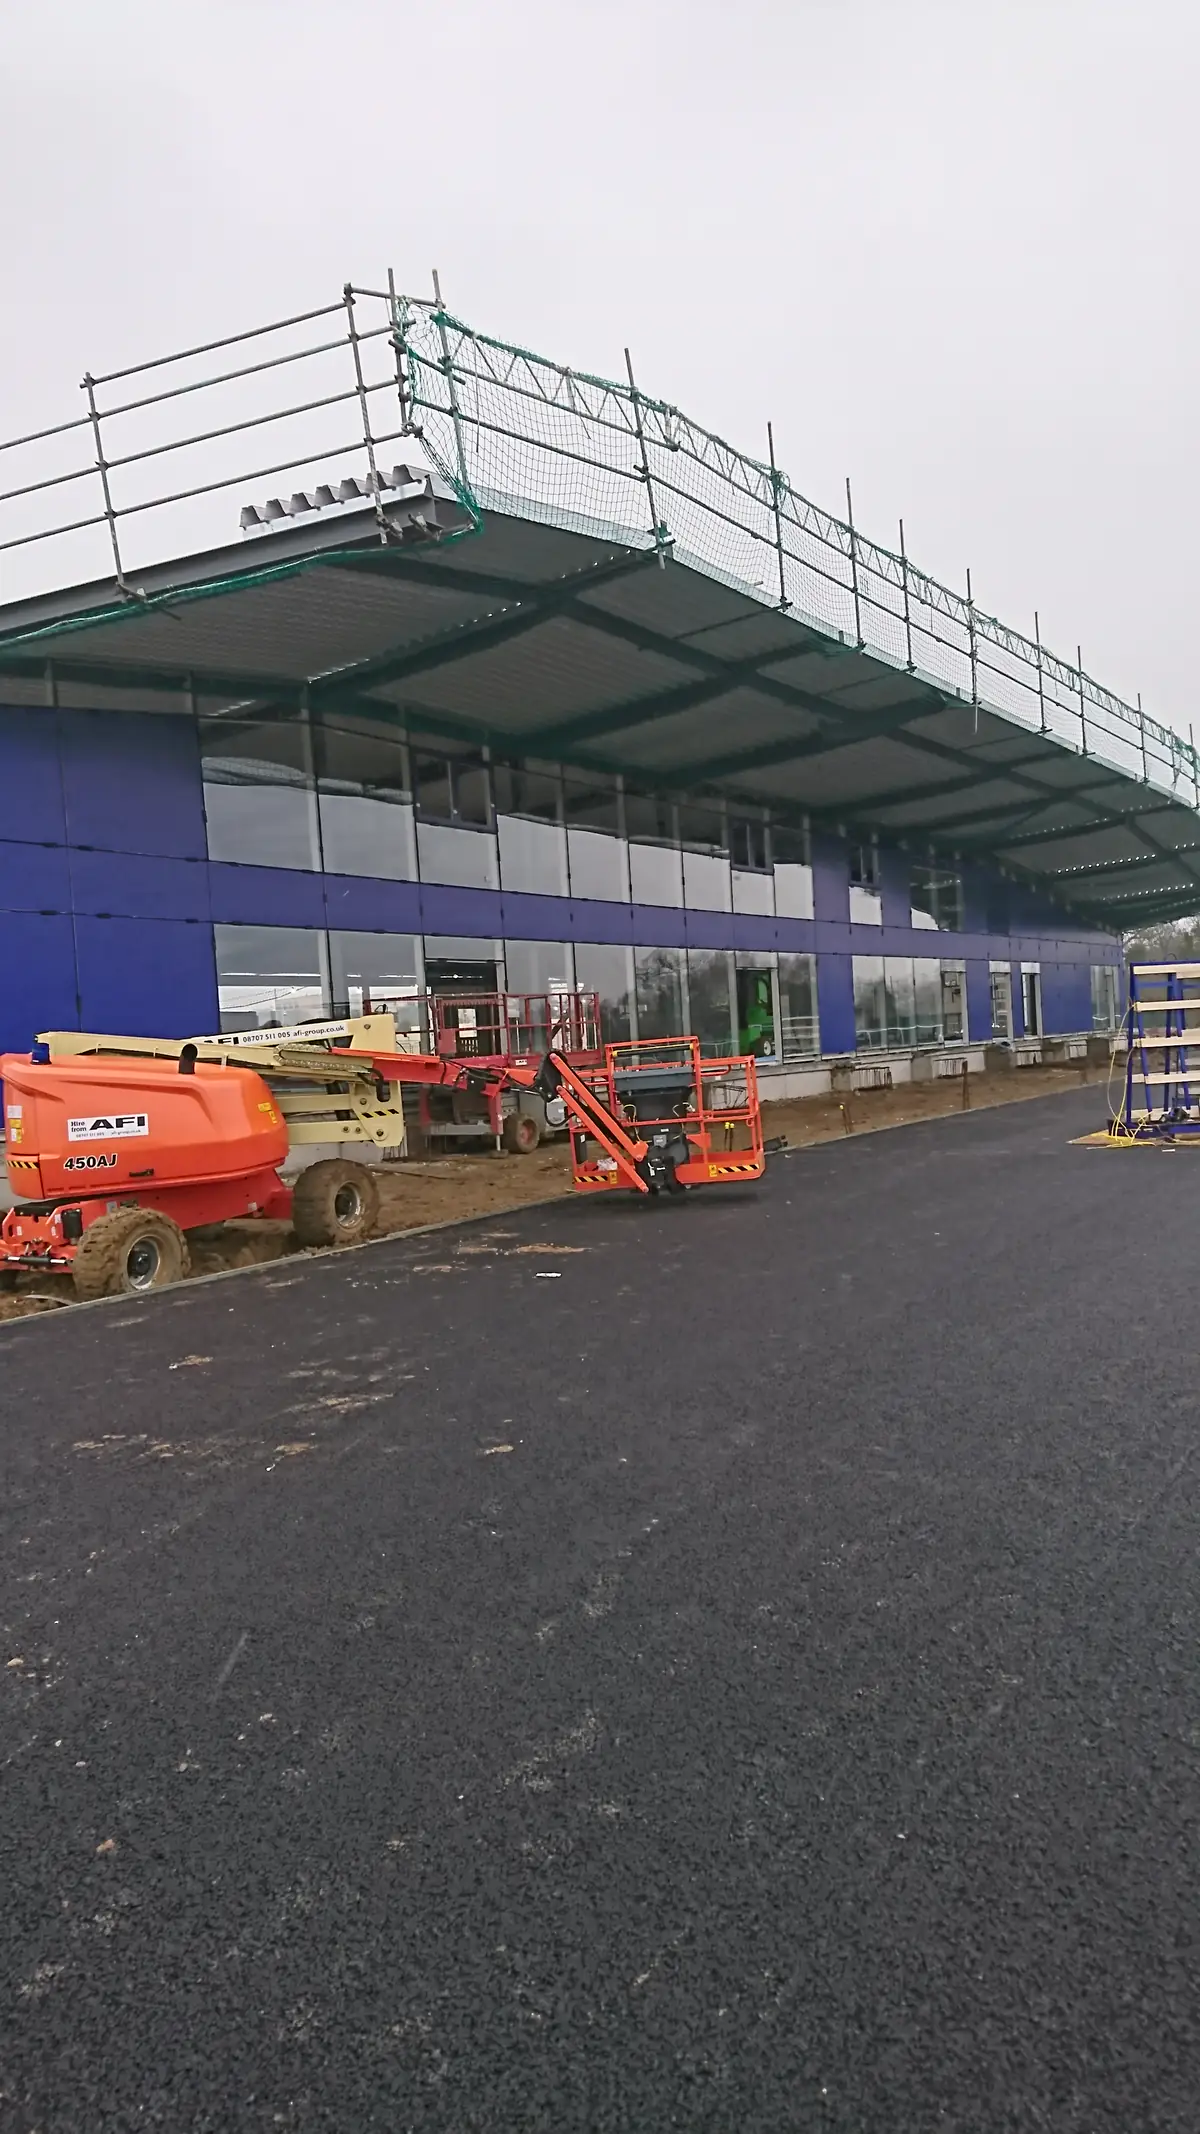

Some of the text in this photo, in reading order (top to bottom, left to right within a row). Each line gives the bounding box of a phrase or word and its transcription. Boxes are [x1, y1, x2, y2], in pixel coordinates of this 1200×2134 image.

[243, 1034, 264, 1043] 08707
[277, 1031, 291, 1039] 005
[293, 1025, 345, 1037] afi-group.co.uk
[89, 1116, 145, 1131] AFI
[64, 1153, 118, 1171] 450AJ
